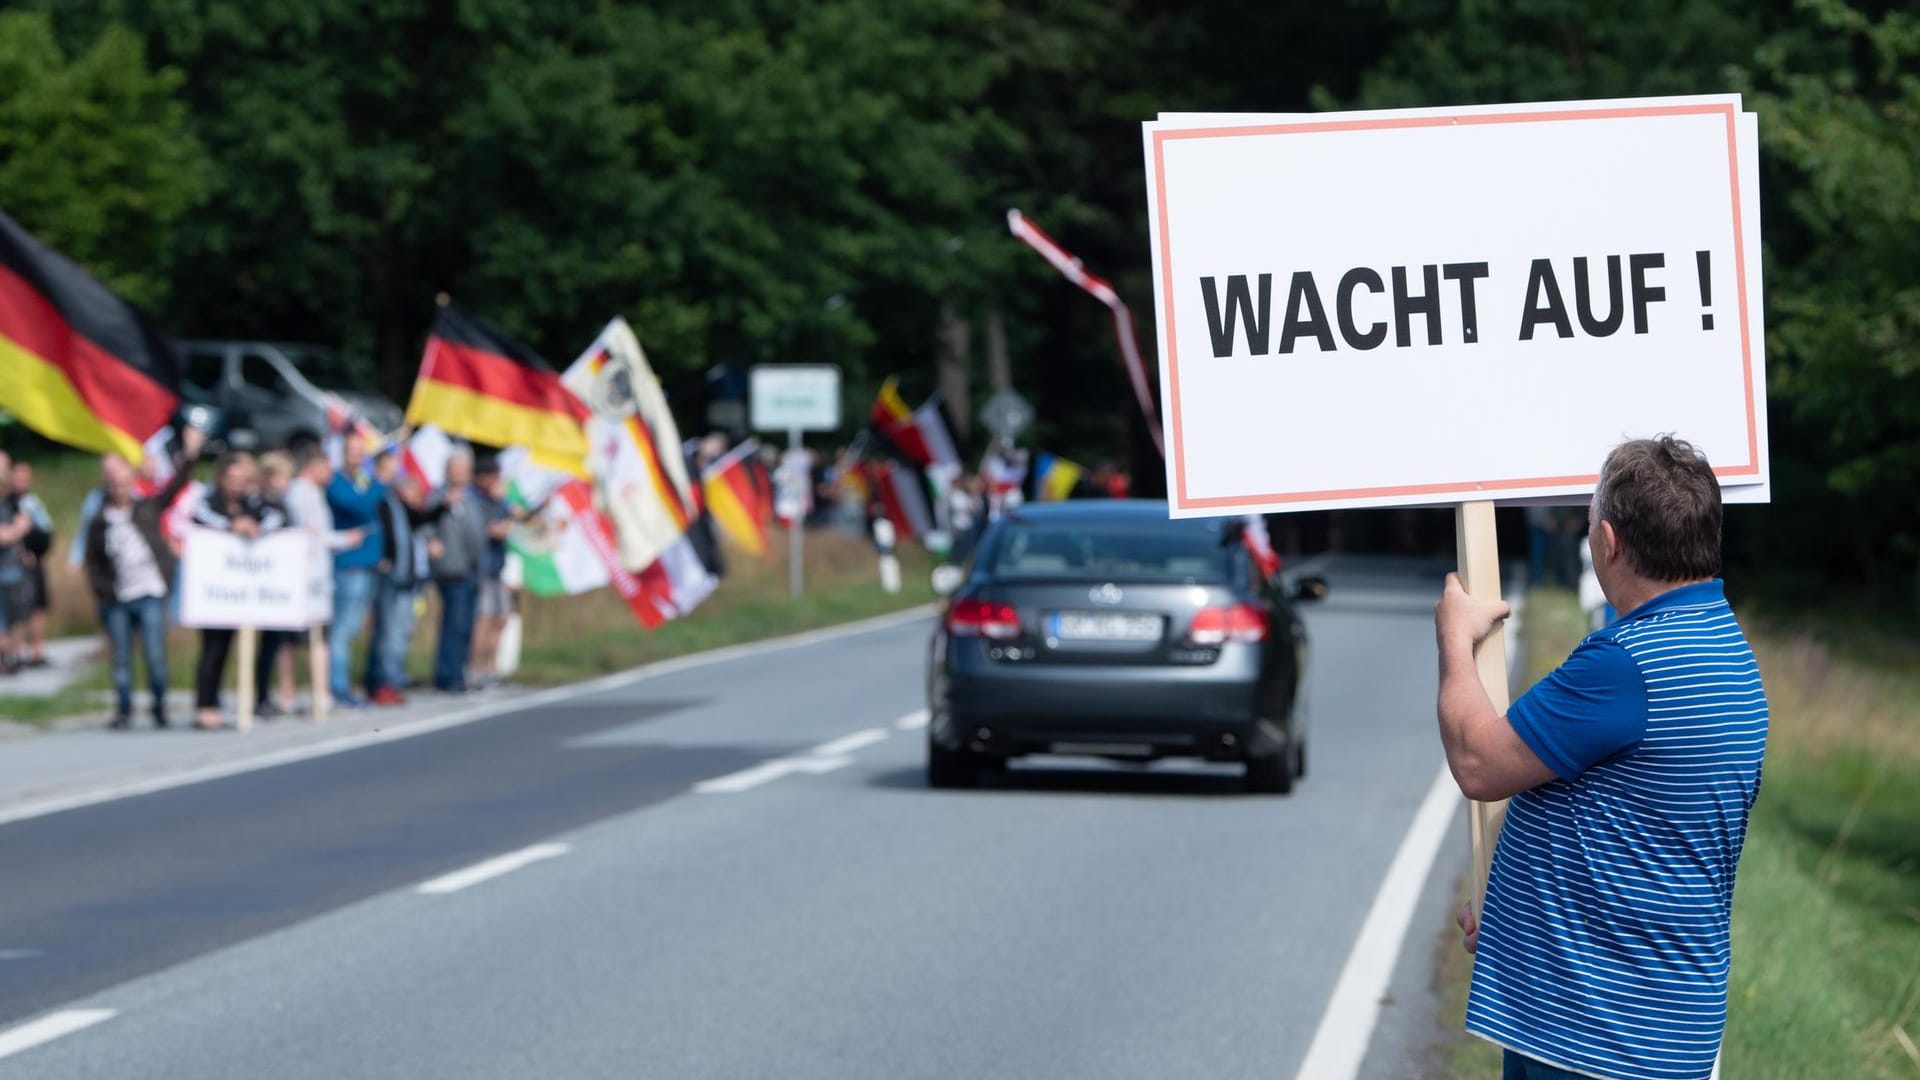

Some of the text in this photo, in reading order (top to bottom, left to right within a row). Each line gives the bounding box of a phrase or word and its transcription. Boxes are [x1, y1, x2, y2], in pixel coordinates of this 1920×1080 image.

[1200, 250, 1715, 358] WACHT AUF !
